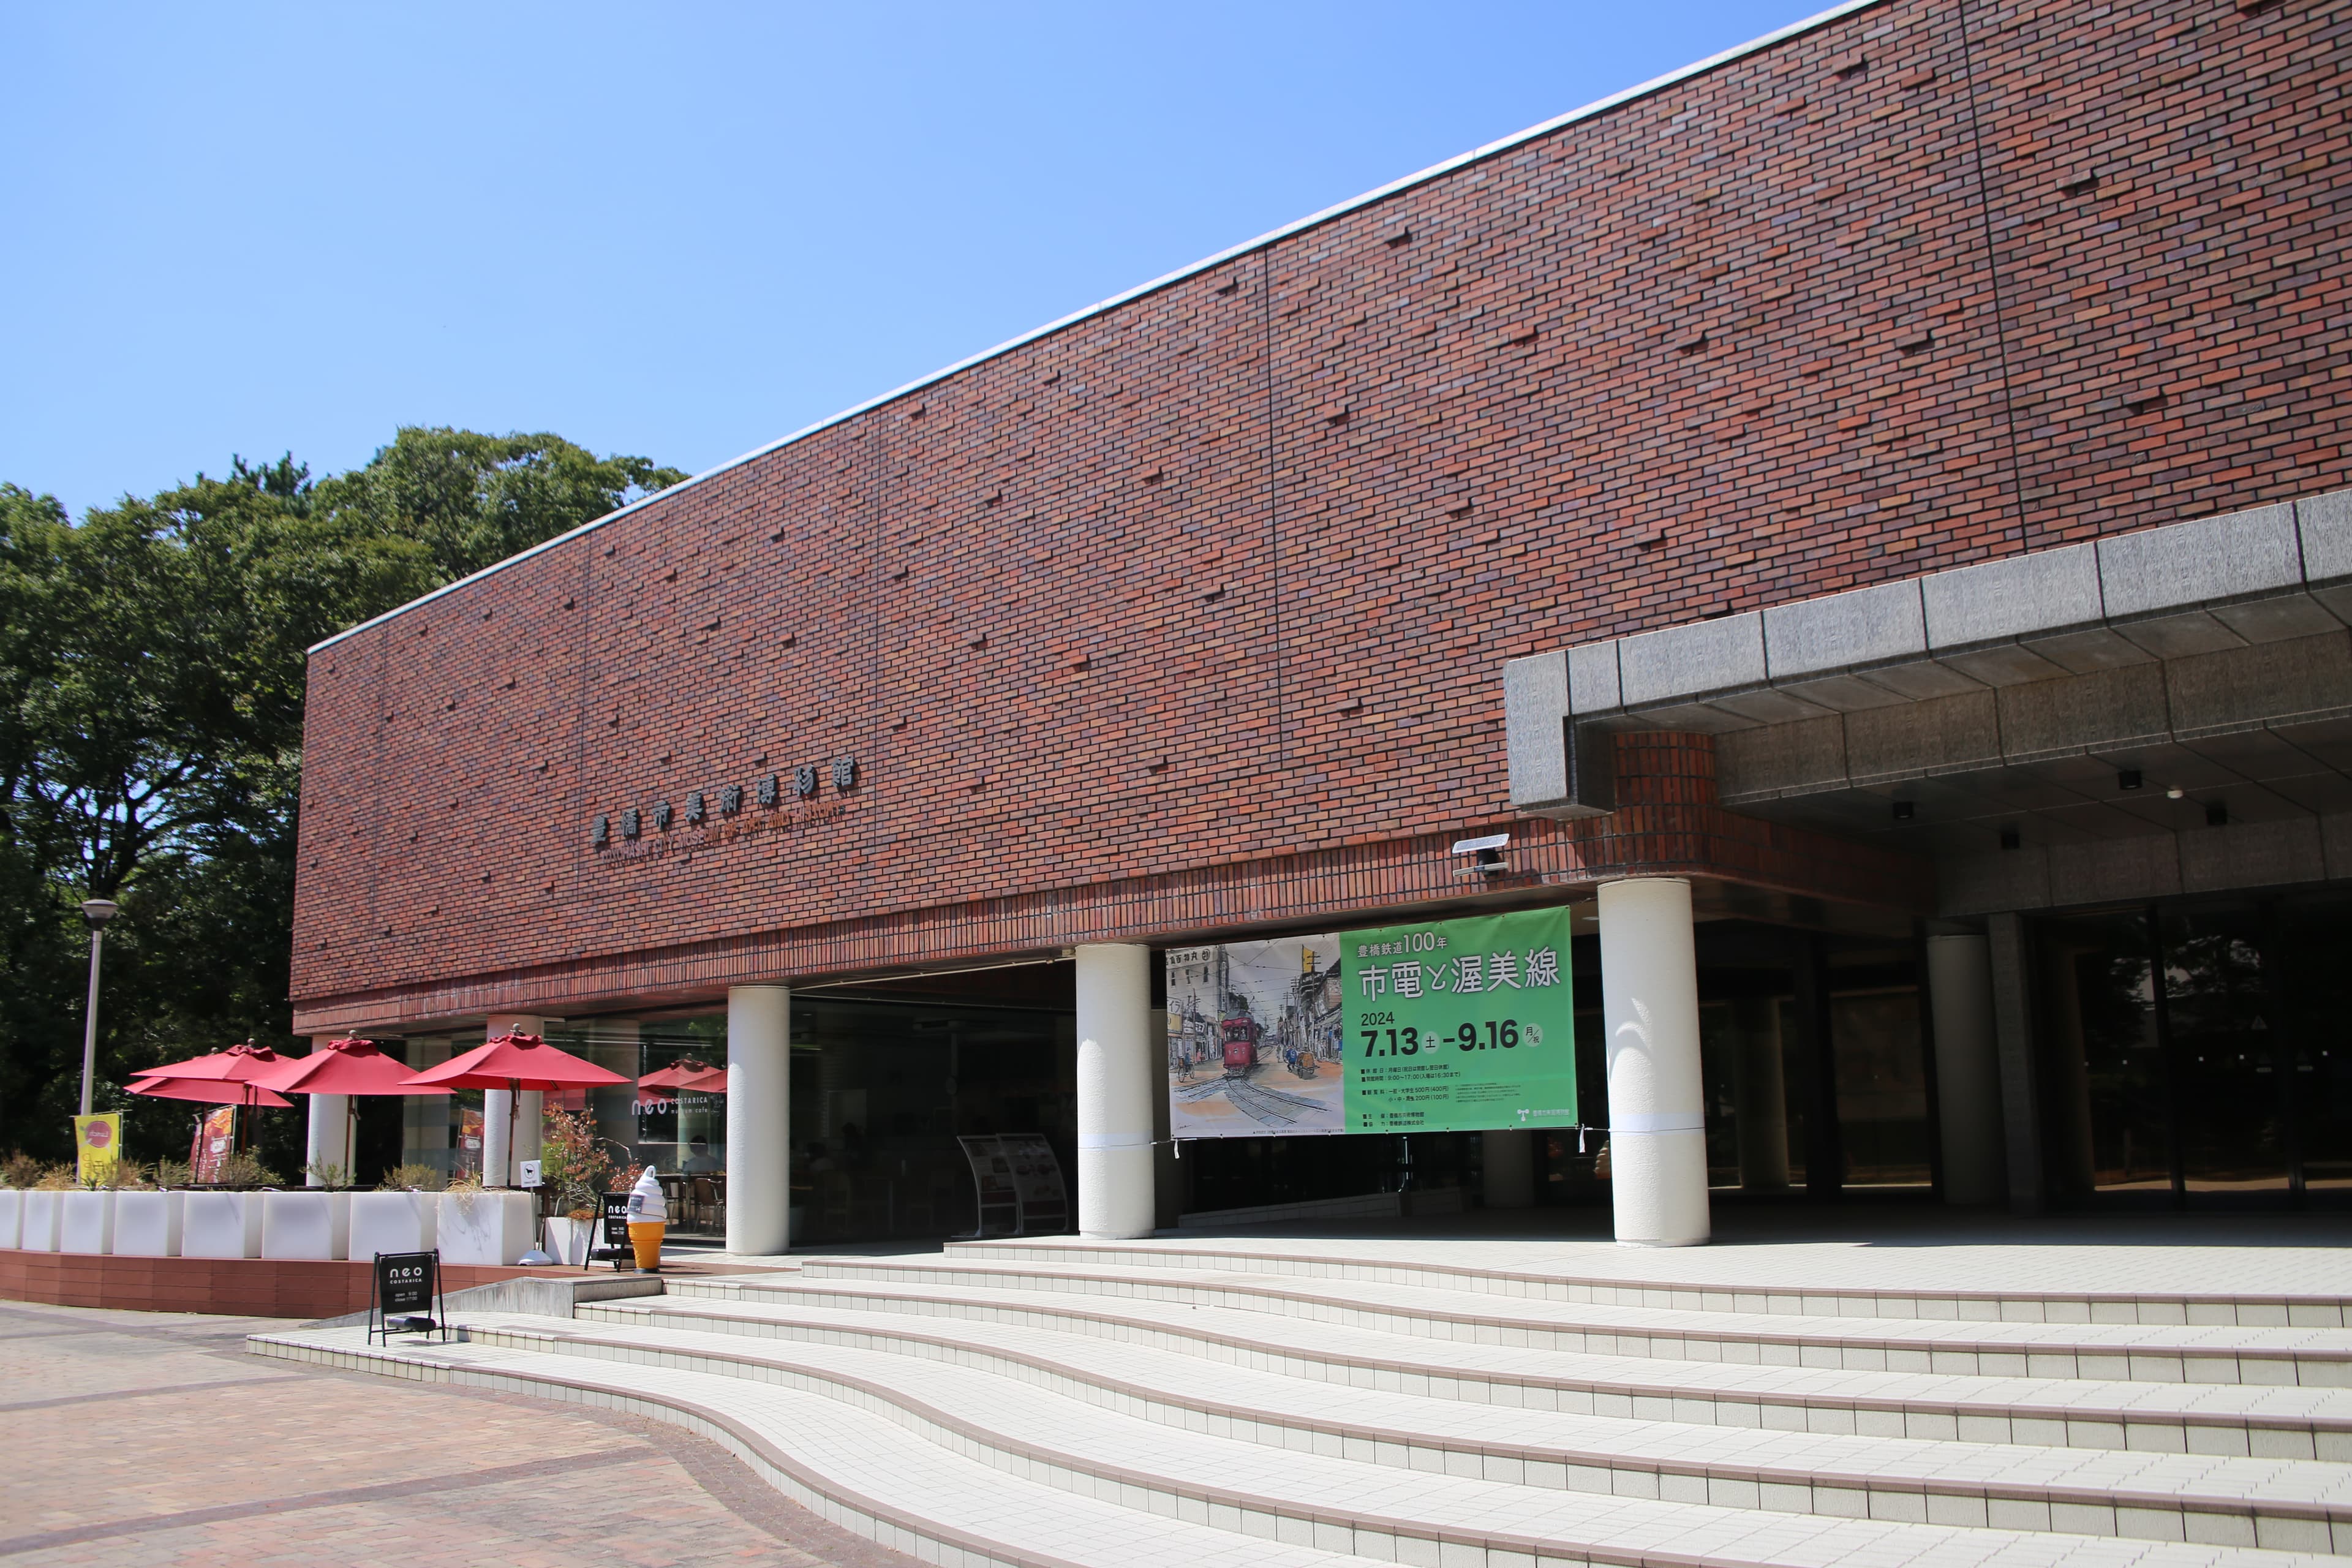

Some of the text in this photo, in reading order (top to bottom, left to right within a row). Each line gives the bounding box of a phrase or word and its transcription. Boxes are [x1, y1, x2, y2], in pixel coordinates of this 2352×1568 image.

[678, 826, 722, 848] MUSEUM
[768, 811, 791, 828] AND
[796, 799, 841, 823] HISTORY
[1357, 931, 1448, 958] 豊橋鉄道100年
[1358, 946, 1561, 1002] 市電と渥美線
[1361, 1011, 1395, 1027] 2024
[631, 1096, 708, 1115] neo COSTARICA
[390, 1267, 423, 1278] neo
